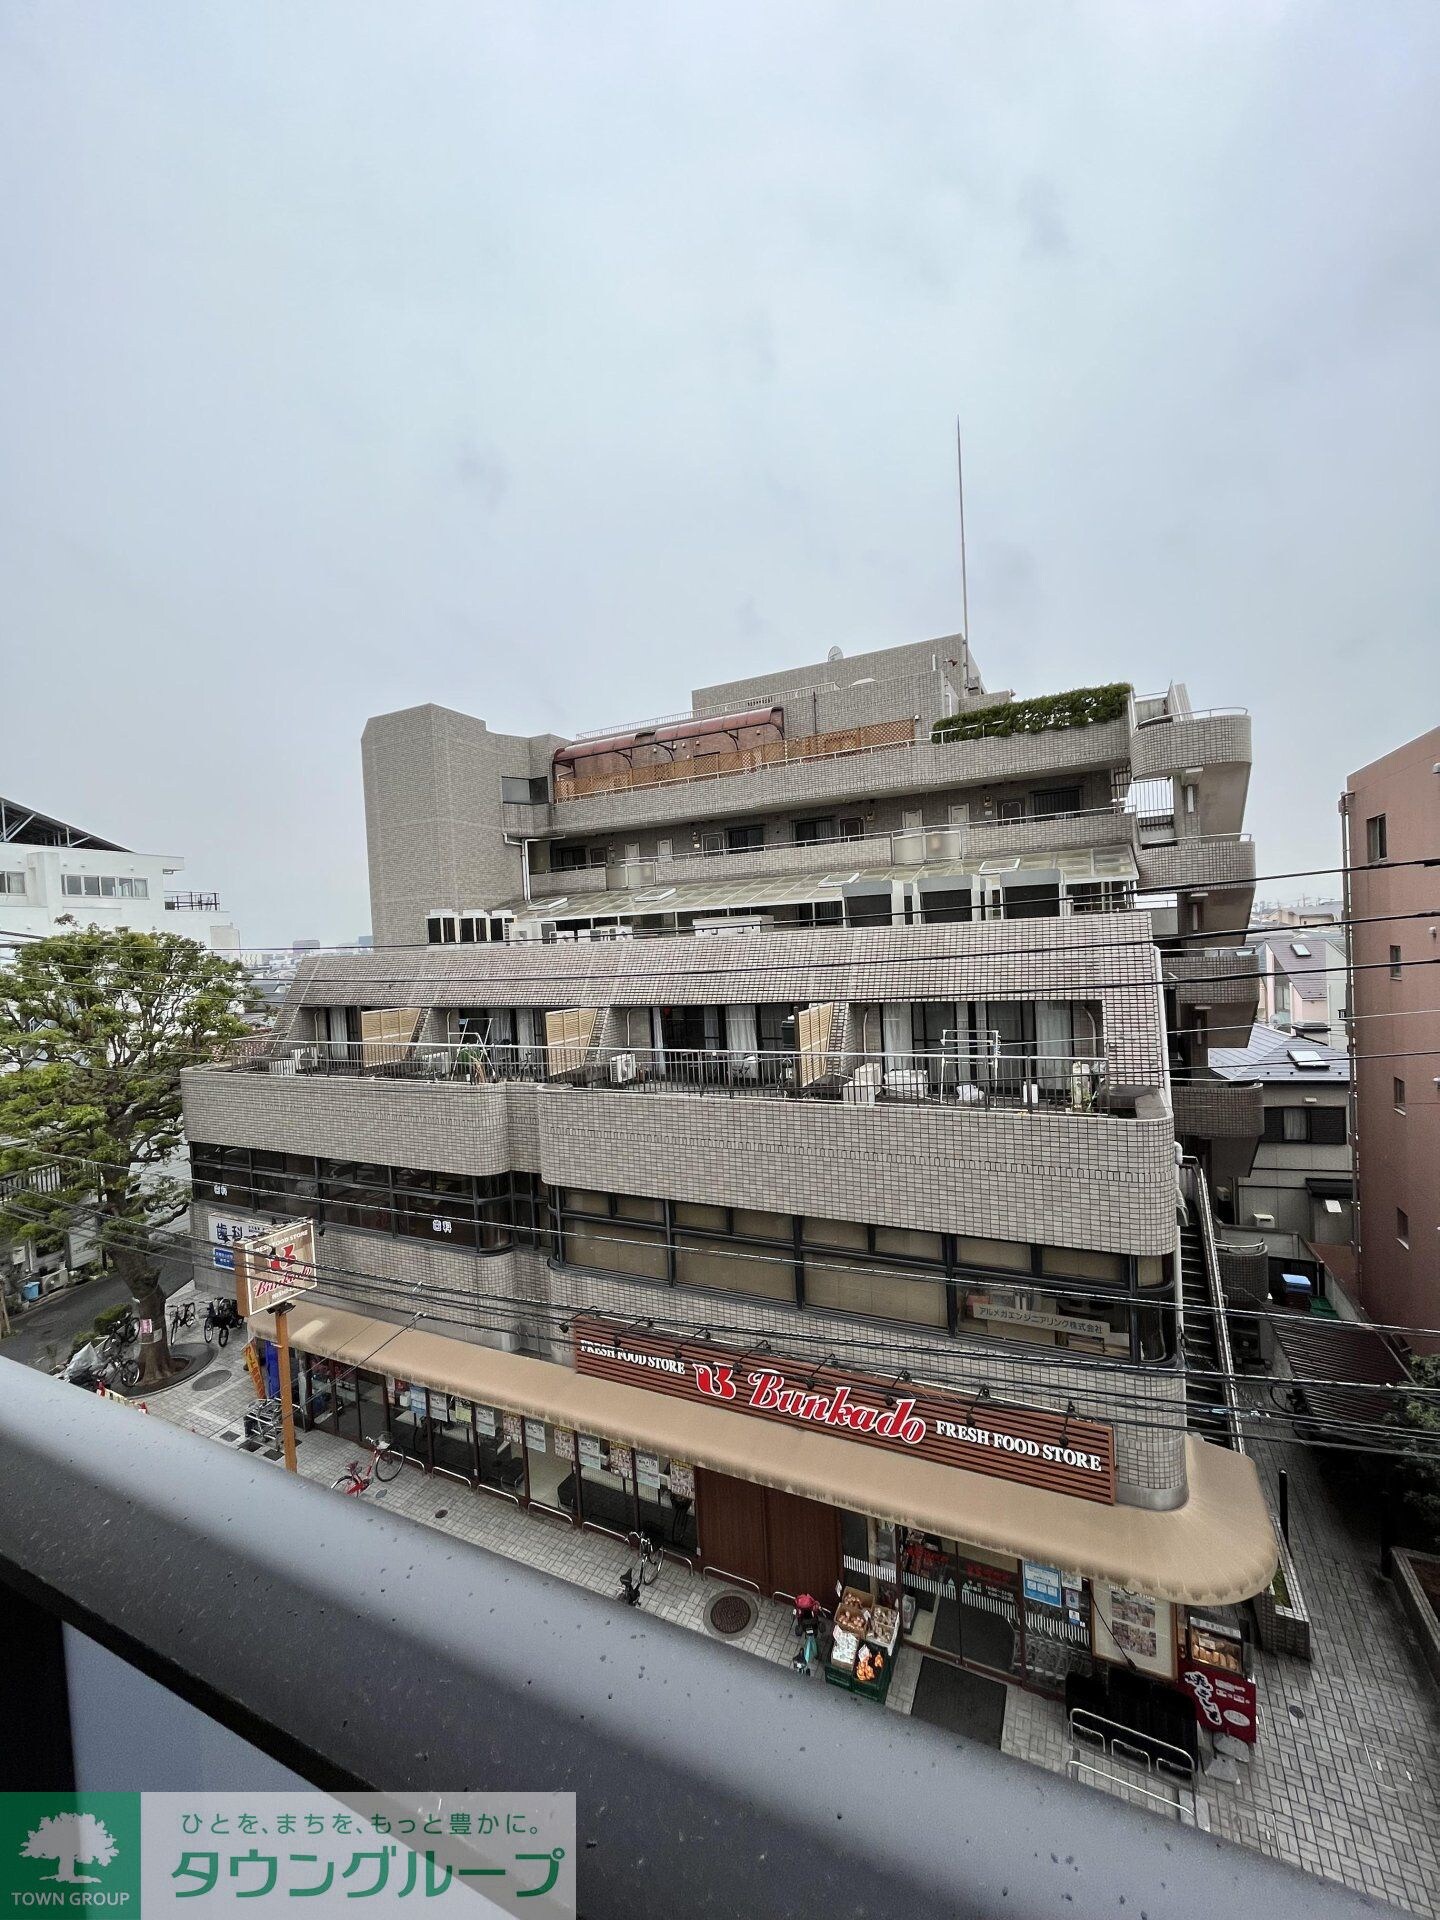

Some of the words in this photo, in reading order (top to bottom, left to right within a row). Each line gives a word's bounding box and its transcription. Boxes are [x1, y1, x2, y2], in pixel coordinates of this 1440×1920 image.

[979, 1306, 1103, 1334] アルメガエンジニアリング株式会社
[617, 1347, 647, 1366] FOOD
[647, 1356, 686, 1375] STORE
[747, 1368, 927, 1445] Bunkado
[935, 1420, 990, 1446] FRESH
[993, 1433, 1040, 1457] FOOD
[1042, 1443, 1102, 1472] STORE
